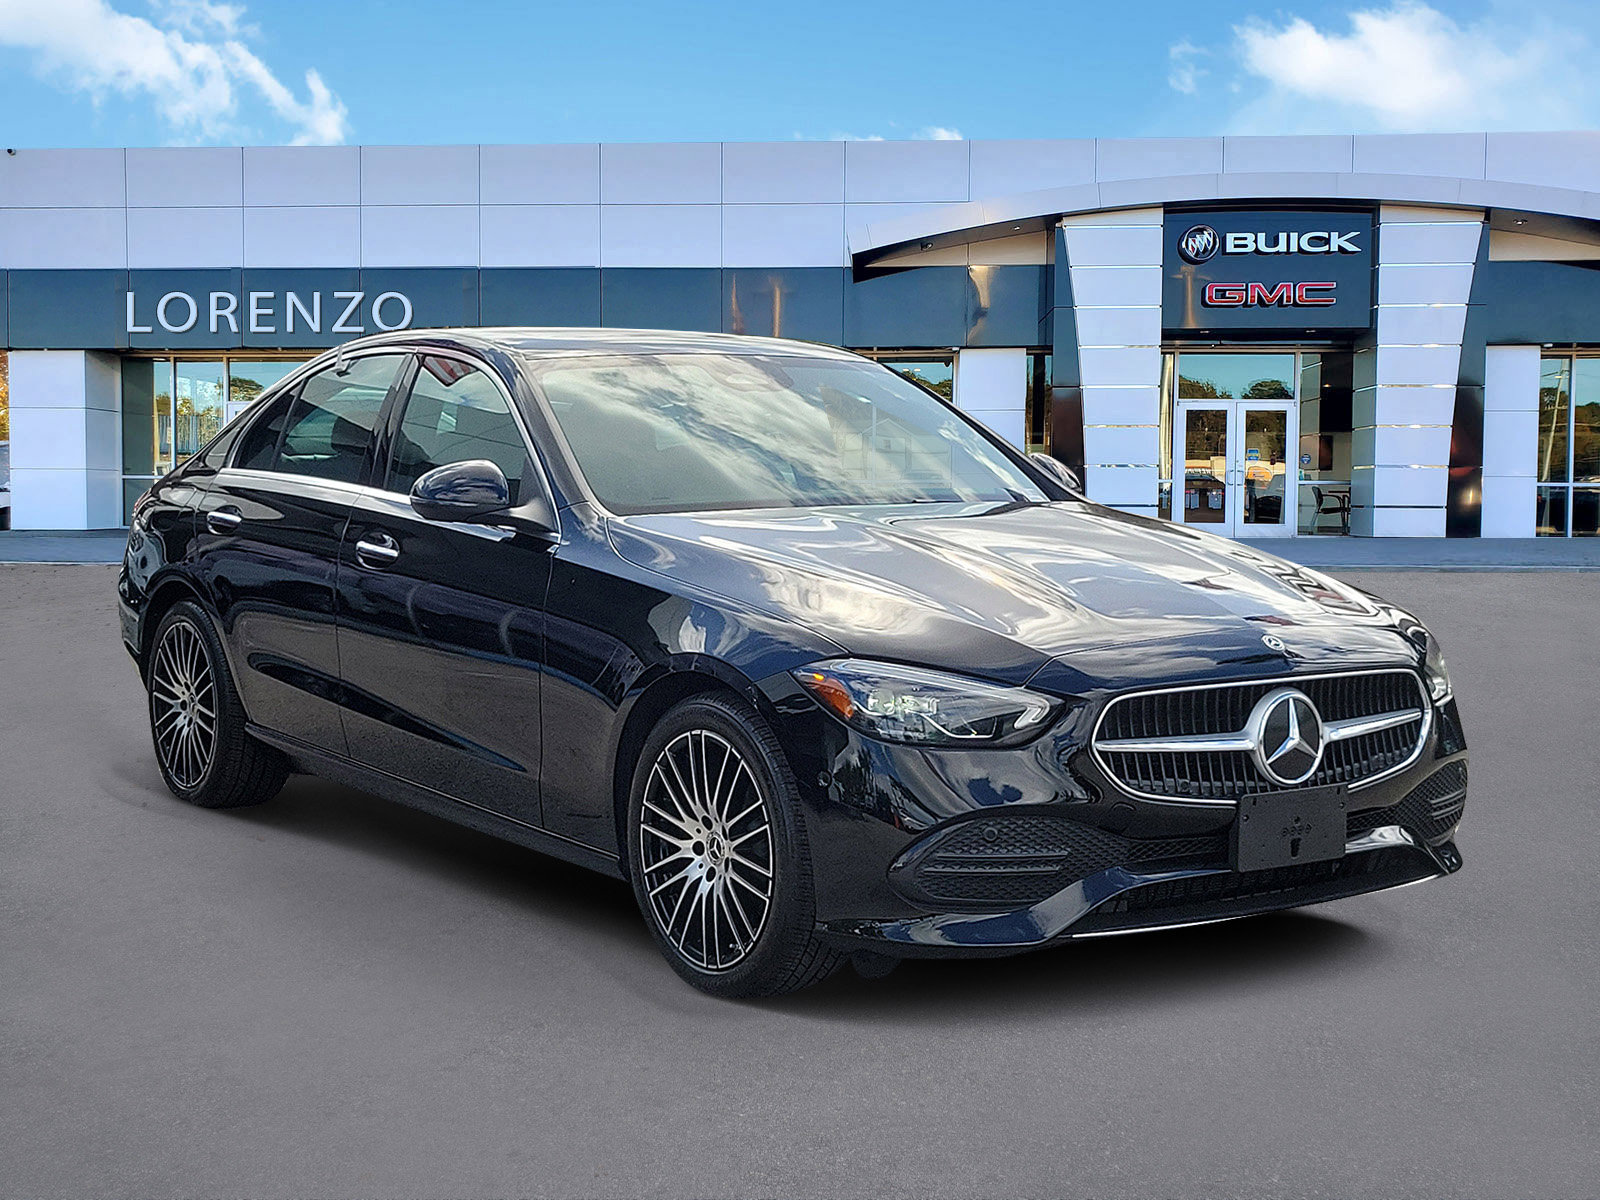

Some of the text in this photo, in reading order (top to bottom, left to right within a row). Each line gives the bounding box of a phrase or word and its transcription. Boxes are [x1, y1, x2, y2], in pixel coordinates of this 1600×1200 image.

[1225, 231, 1362, 253] BUICK
[1204, 281, 1337, 306] GMC
[125, 291, 414, 333] LORENZO
